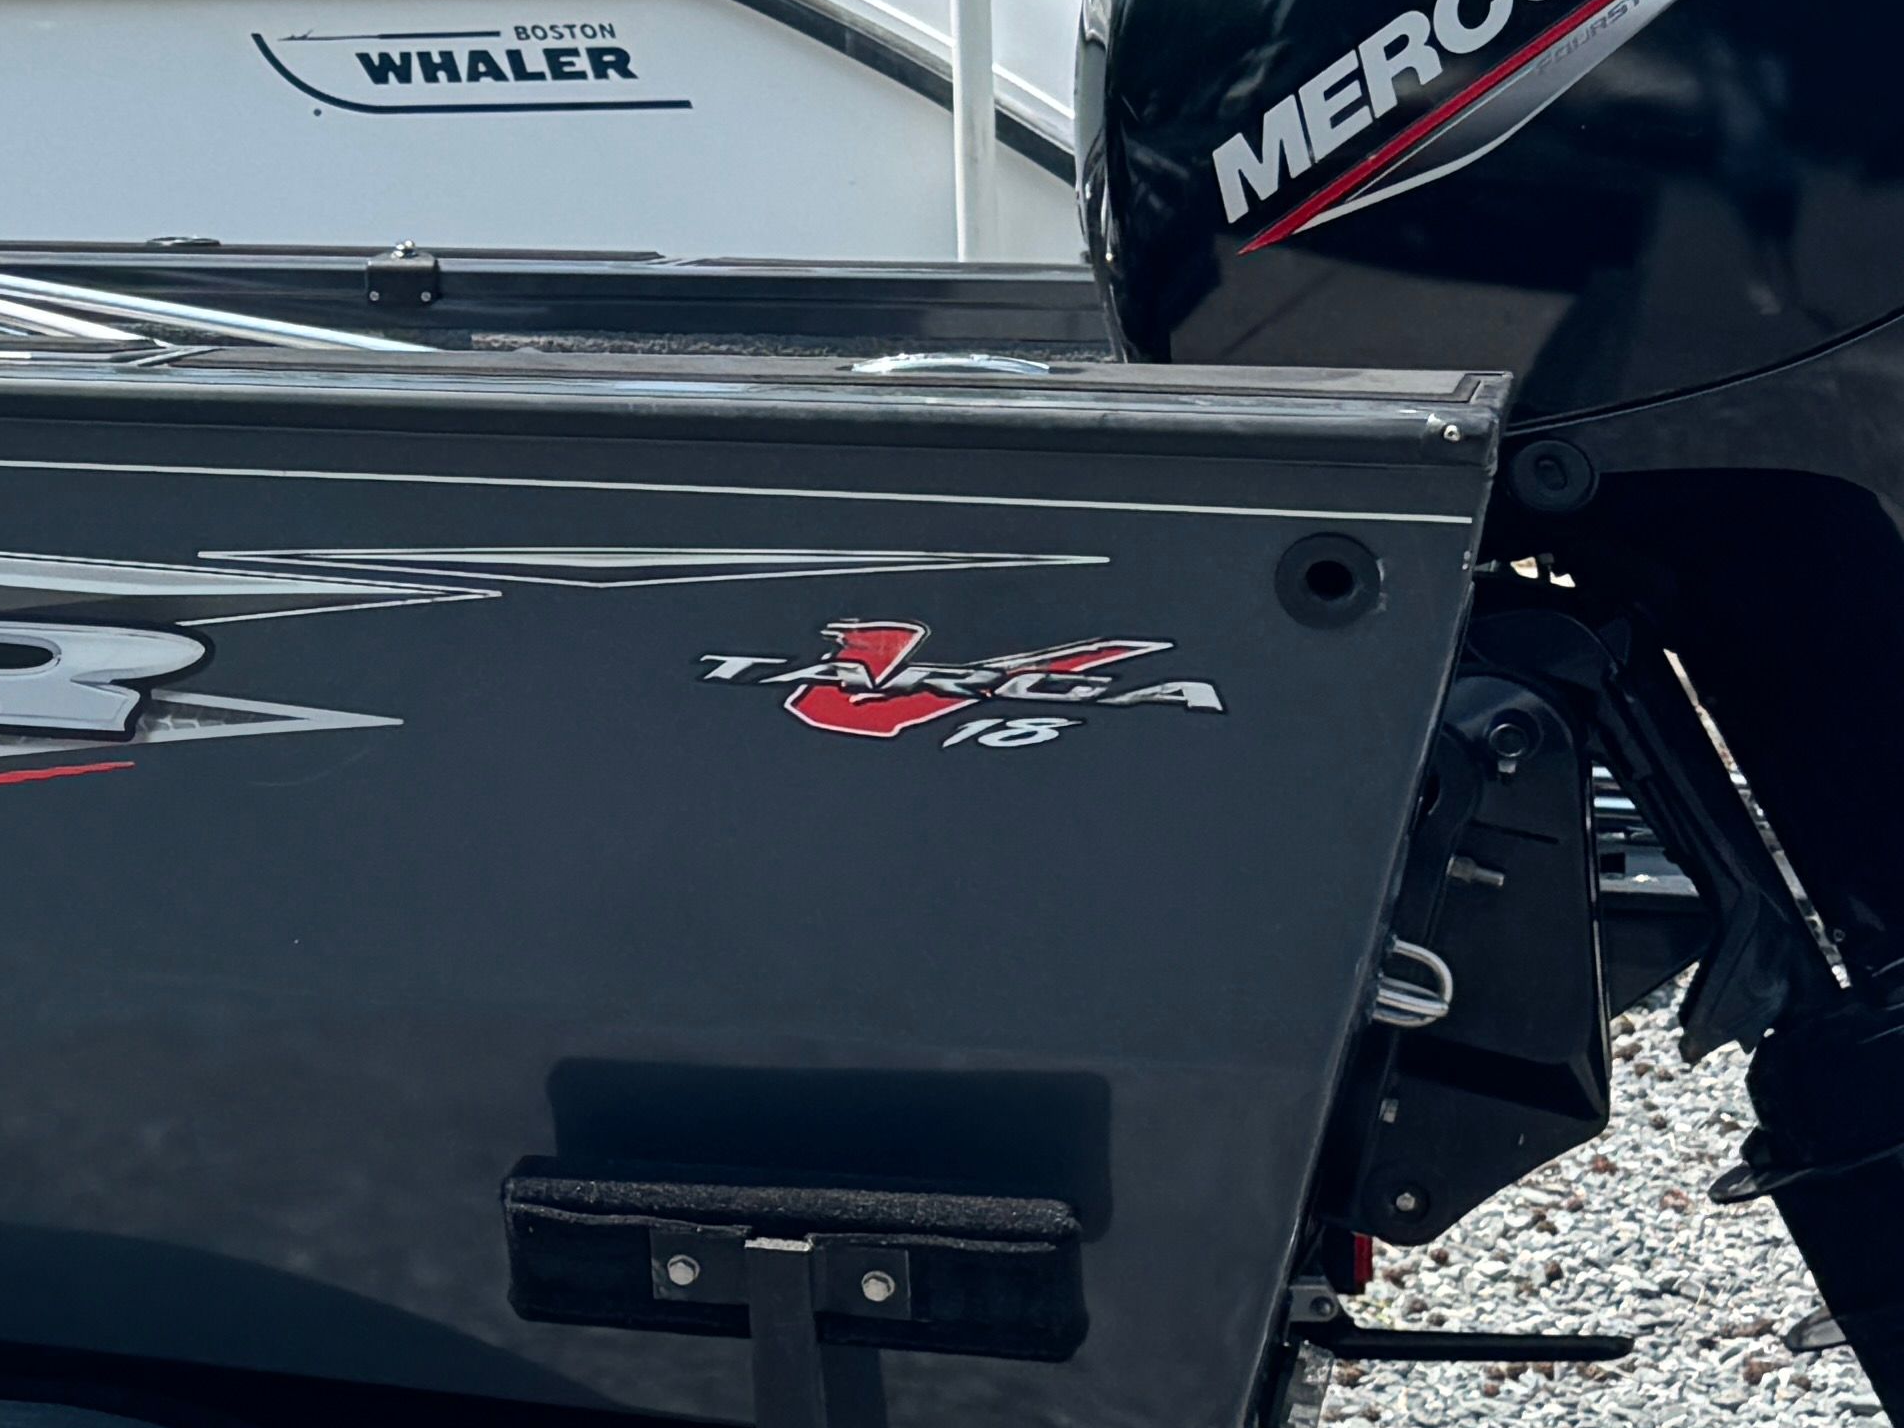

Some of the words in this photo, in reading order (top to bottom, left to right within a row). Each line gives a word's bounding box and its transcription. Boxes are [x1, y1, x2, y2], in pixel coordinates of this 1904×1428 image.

[513, 22, 617, 42] BOSTON
[354, 46, 639, 85] WHALER
[698, 652, 1227, 713] TARGA
[942, 717, 1085, 749] 18
